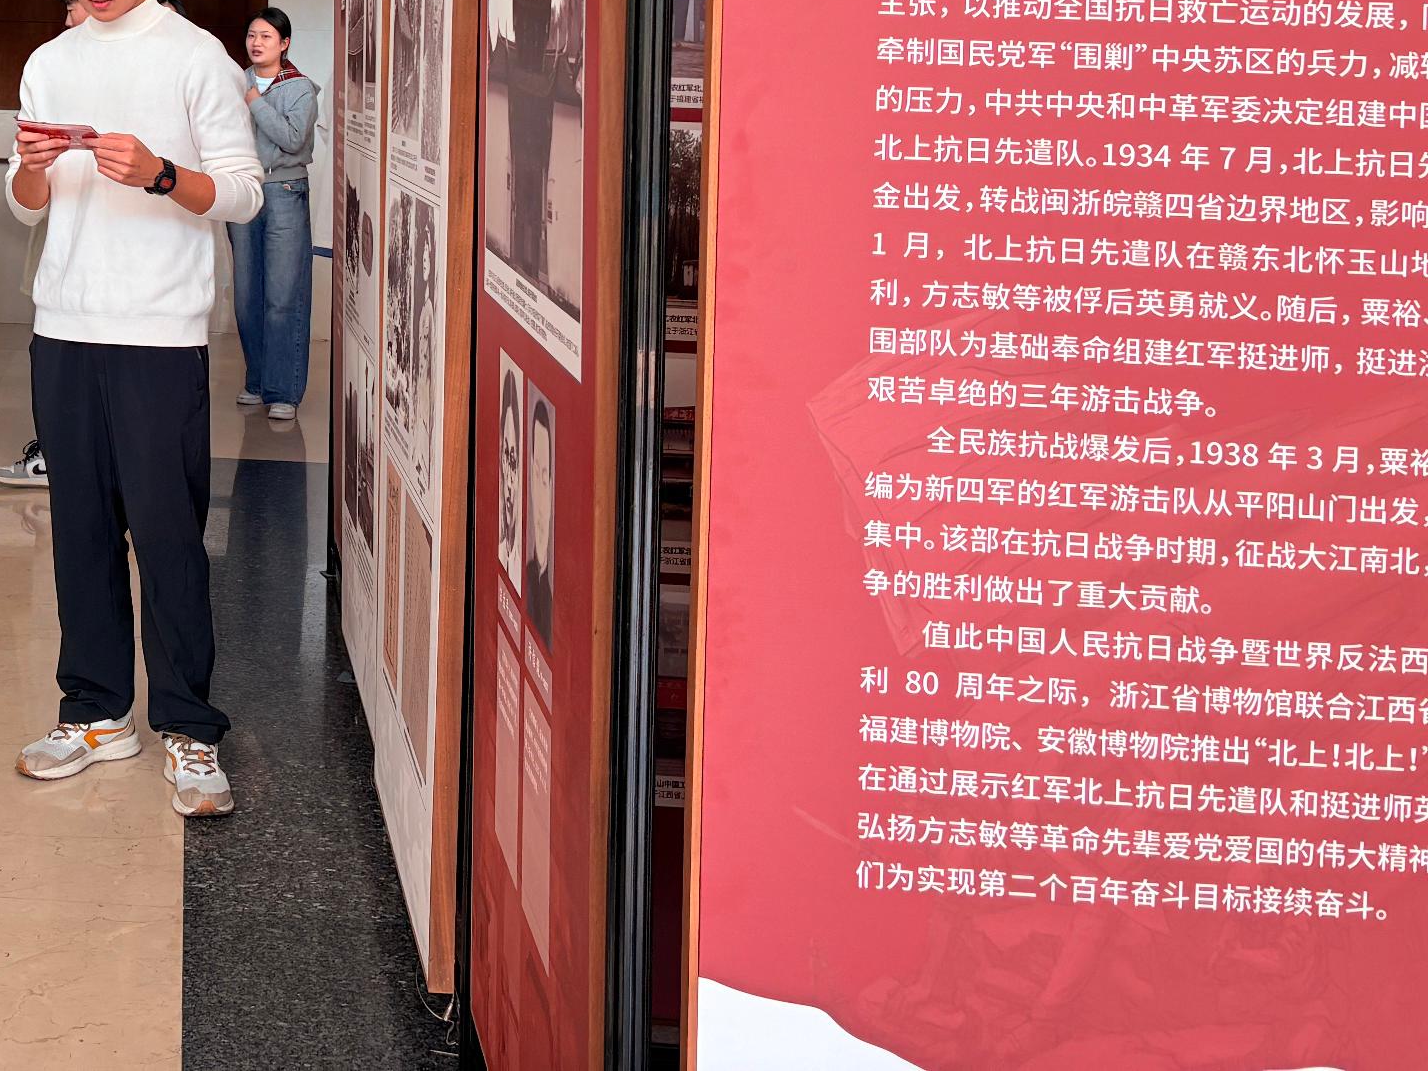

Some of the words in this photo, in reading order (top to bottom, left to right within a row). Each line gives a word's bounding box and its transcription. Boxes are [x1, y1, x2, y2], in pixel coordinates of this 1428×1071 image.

[877, 37, 1428, 79] 牵制国民党军“围剿”中央苏区的兵力，减
[868, 376, 1215, 417] 艰苦卓绝的三年游击战争。
[863, 569, 1211, 614] 争的胜利做出了重大贡献。
[856, 861, 1386, 920] 们为实现第二个百年奋斗目标接续奋斗。
